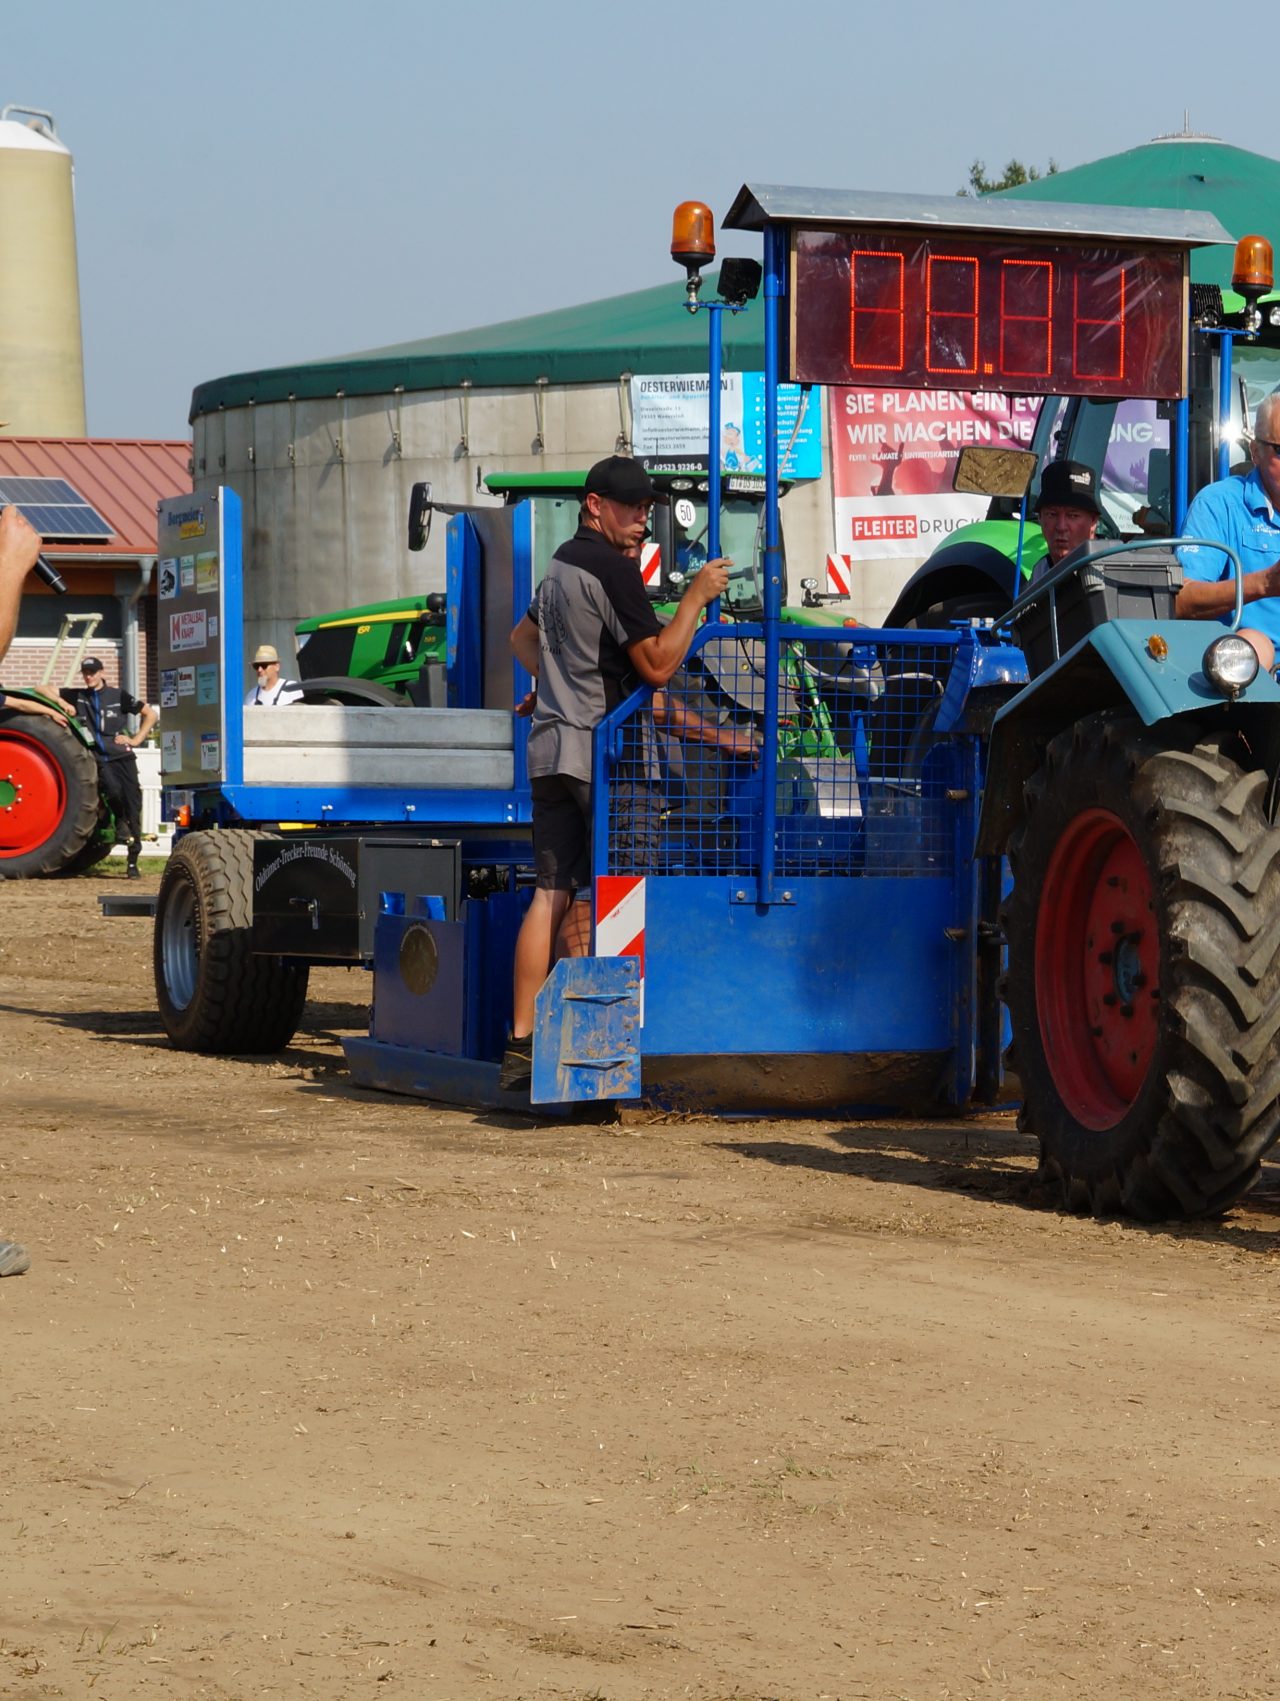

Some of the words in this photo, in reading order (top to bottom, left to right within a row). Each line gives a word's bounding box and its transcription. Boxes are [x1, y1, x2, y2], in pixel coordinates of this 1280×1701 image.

[640, 379, 728, 393] OESTERWIEMAN
[846, 394, 874, 414] SIE
[882, 391, 965, 413] PLANEN
[972, 391, 1007, 412] EIN
[847, 424, 887, 444] WIR
[894, 421, 991, 443] MACHEN
[999, 421, 1032, 441] DIE
[681, 505, 691, 520] 50
[855, 519, 915, 537] FLEITER
